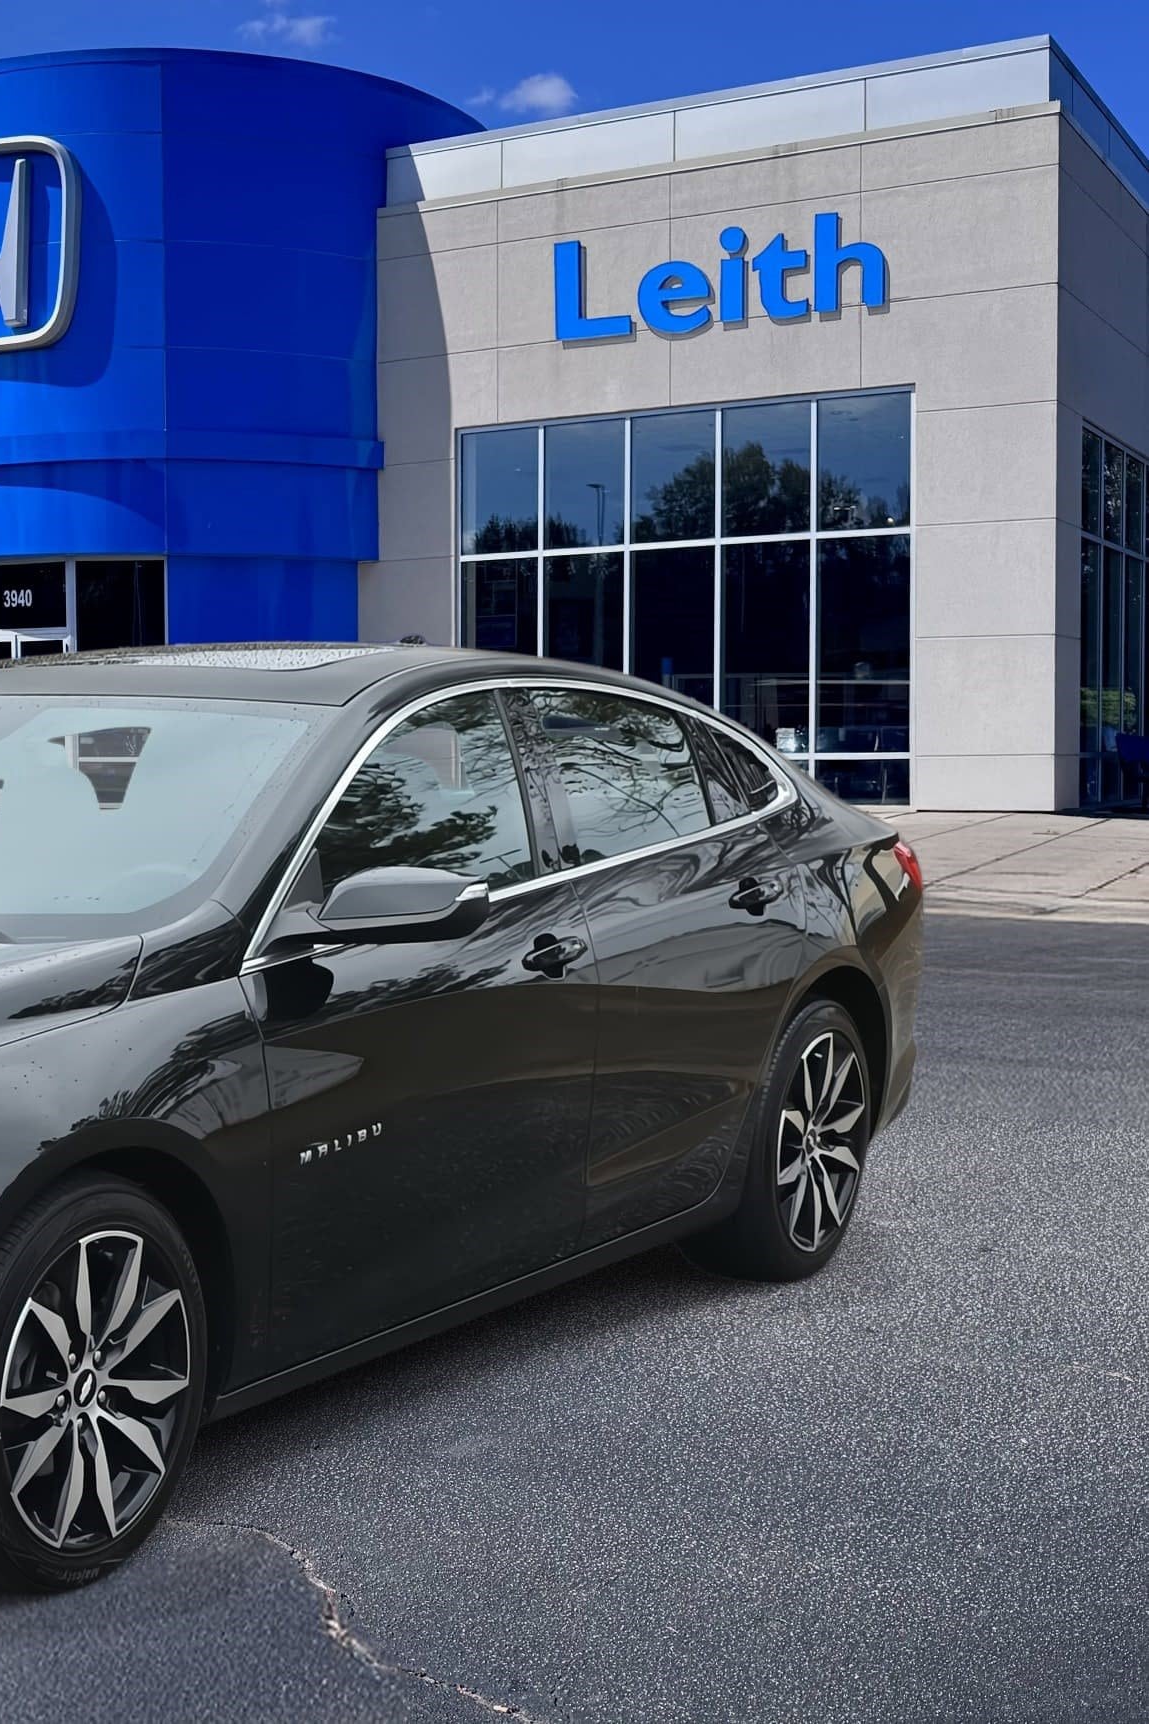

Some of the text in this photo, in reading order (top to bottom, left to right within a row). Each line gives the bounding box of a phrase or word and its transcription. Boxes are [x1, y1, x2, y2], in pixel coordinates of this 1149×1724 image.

[553, 212, 887, 342] Leith
[3, 589, 33, 608] 3940
[299, 1122, 382, 1166] MALIBU
